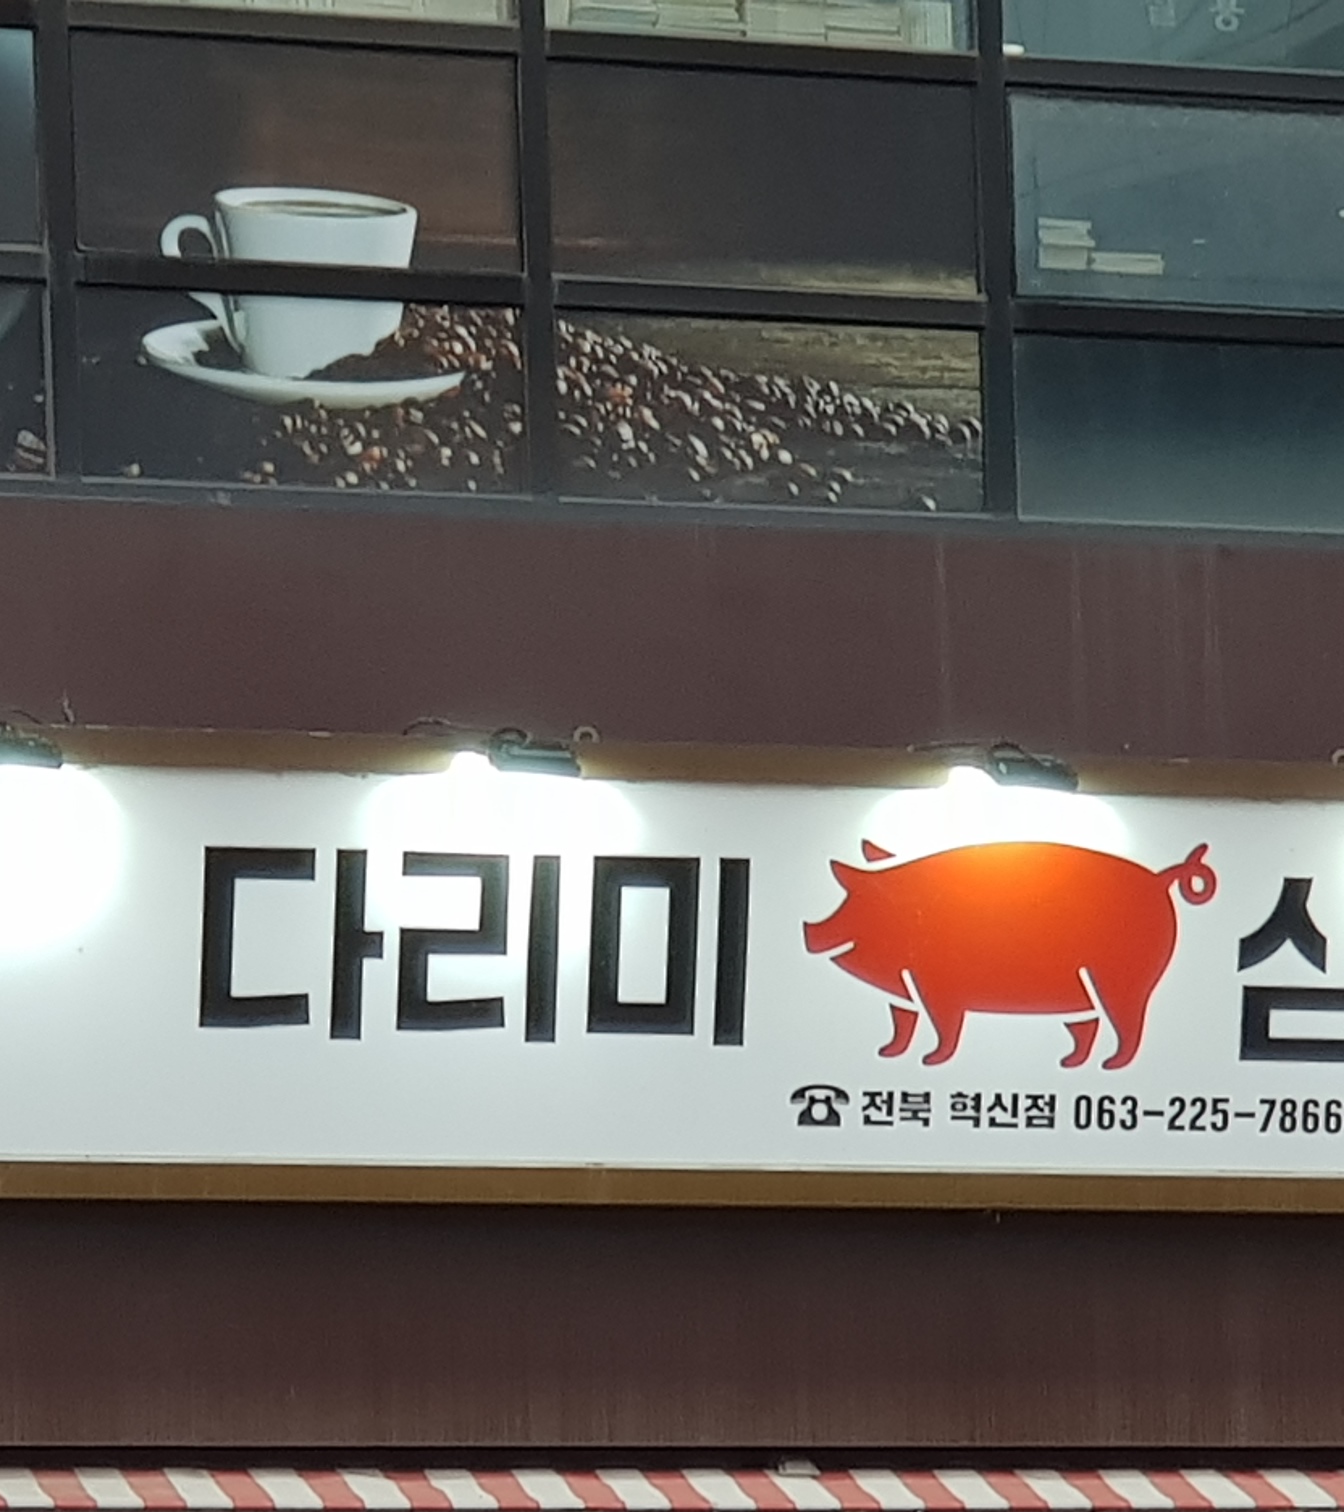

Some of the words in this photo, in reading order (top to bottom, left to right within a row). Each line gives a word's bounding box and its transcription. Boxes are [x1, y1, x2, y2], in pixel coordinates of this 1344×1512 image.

[198, 845, 751, 1047] 다리미
[861, 1089, 933, 1128] 전북
[949, 1090, 1058, 1130] 혁신점
[1072, 1094, 1344, 1134] 063-225-7866
